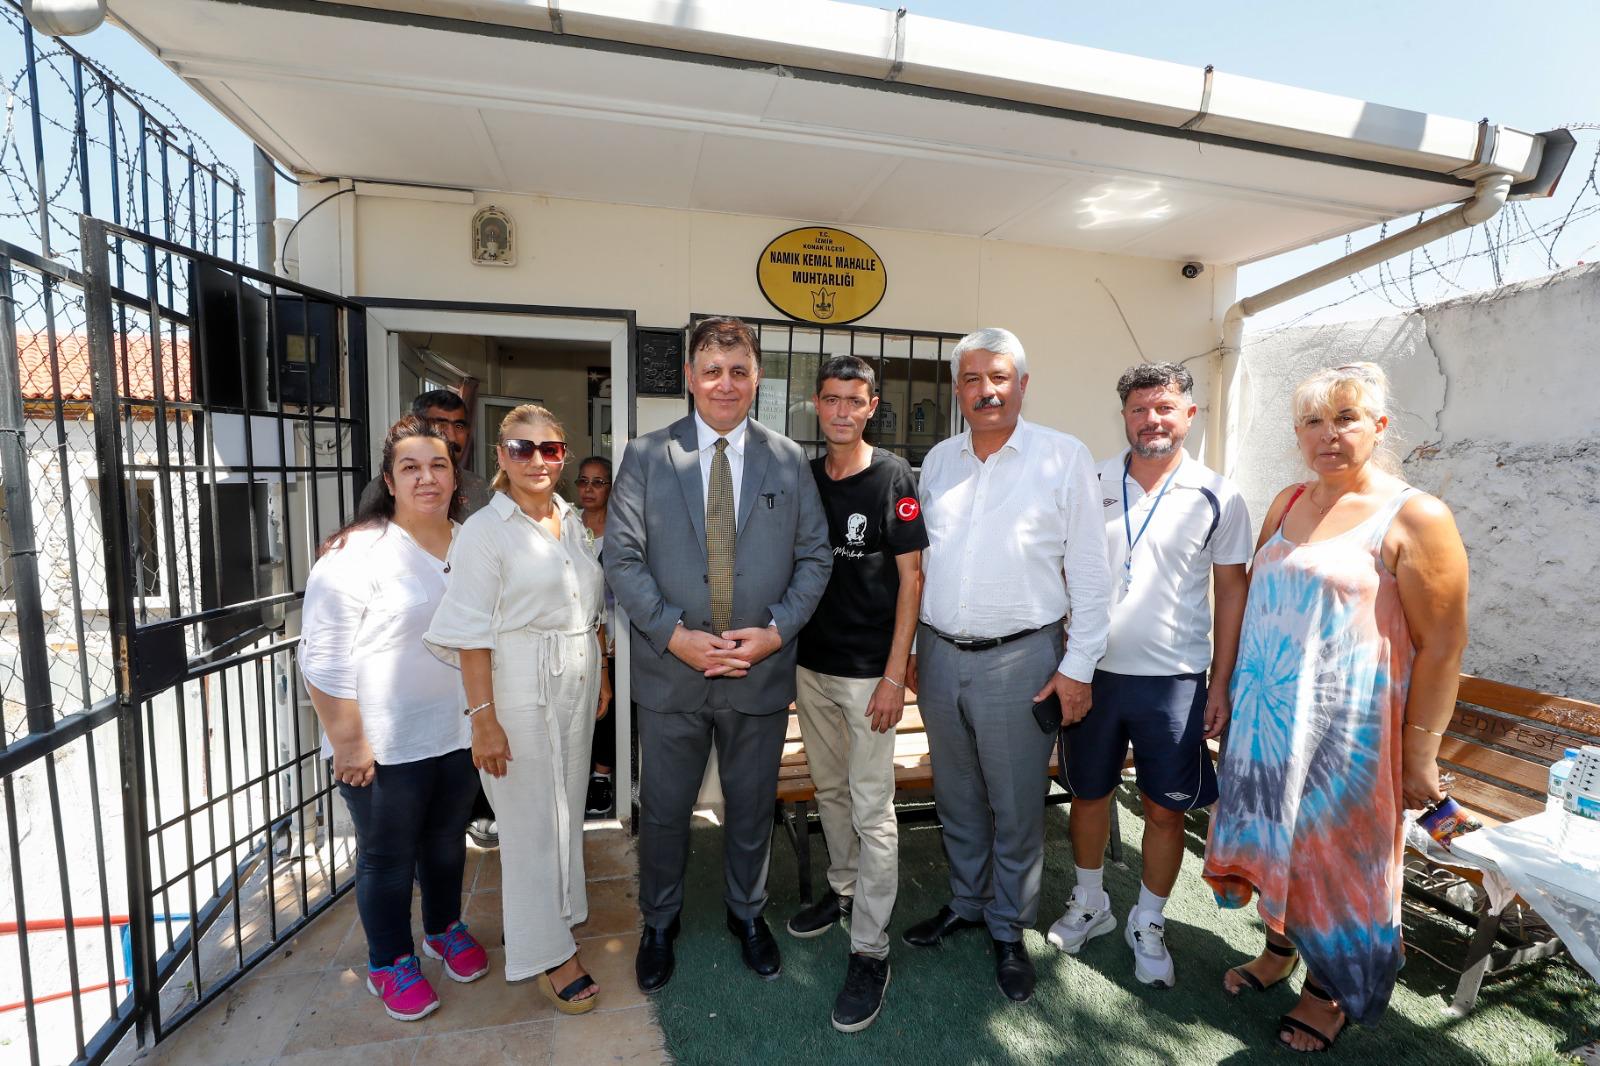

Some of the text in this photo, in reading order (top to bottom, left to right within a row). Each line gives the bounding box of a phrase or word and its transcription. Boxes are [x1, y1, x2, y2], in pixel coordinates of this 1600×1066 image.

[802, 243, 823, 251] KONAK
[770, 251, 876, 271] NAMIK KEMAL MAHALLE
[792, 271, 854, 287] MUHTARLIĞI
